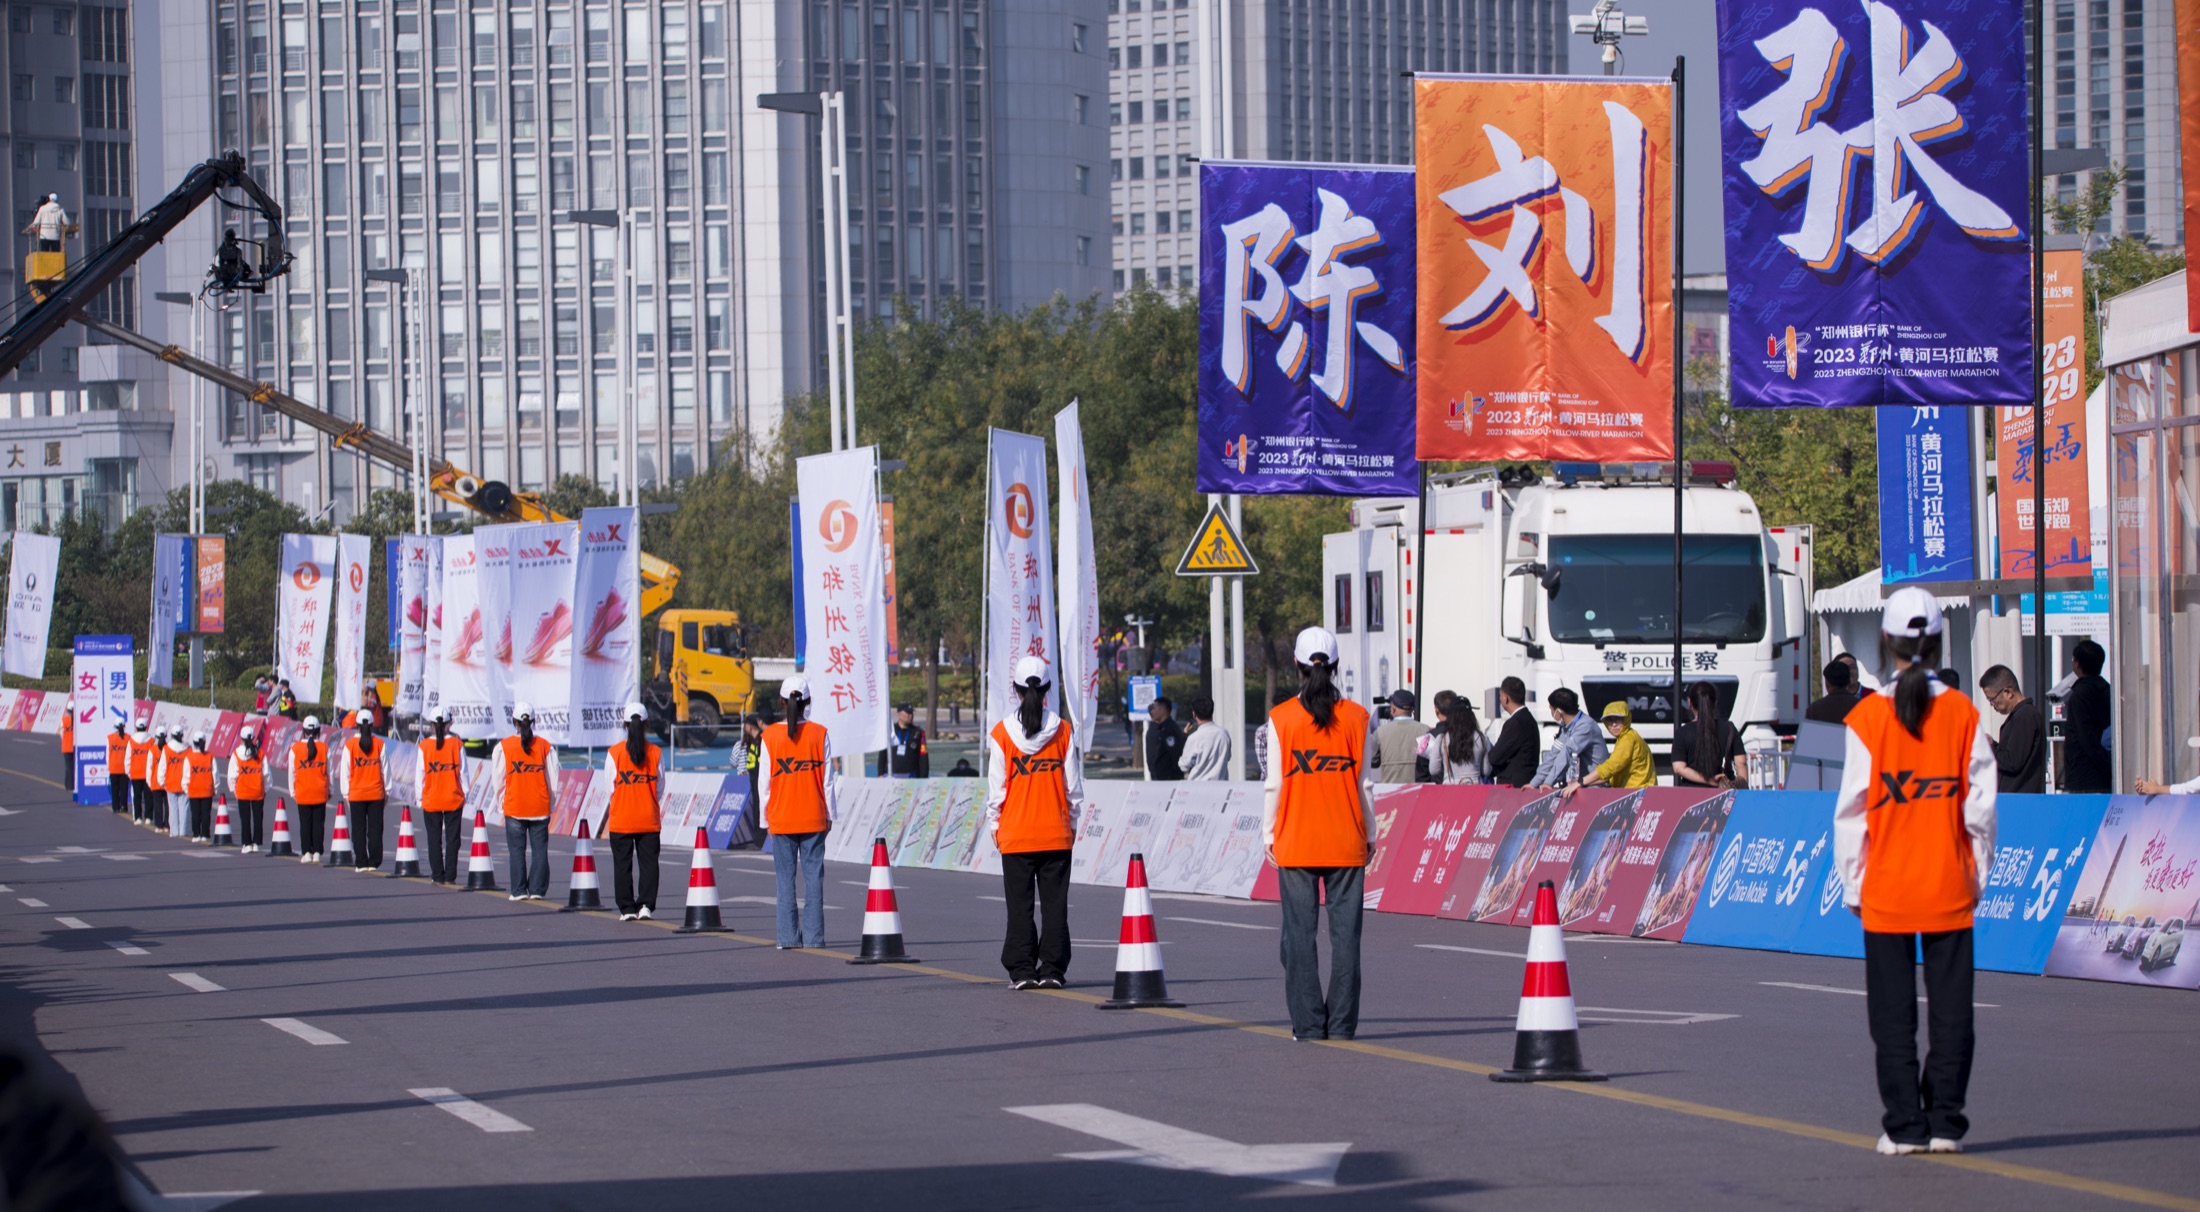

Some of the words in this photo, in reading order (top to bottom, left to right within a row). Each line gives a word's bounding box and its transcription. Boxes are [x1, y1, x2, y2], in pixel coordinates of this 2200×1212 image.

[1737, 0, 2020, 270] 张
[1438, 101, 1652, 372] 刘
[1220, 187, 1407, 415] 陈
[1814, 348, 1856, 364] 2023
[1814, 370, 1835, 379] 2023
[1950, 368, 2000, 378] MARATHON
[1486, 411, 1521, 424] 2023
[1601, 430, 1644, 438] MARATHON
[7, 441, 62, 468] 大厦
[1258, 452, 1289, 464] 2023
[1008, 552, 1020, 589] BANK
[1012, 593, 1021, 614] OF
[1603, 651, 1627, 671] 警
[1632, 656, 1691, 668] POLIE
[1694, 651, 1718, 671] 察
[78, 671, 97, 691] 女
[110, 672, 127, 691] 男
[426, 762, 460, 774] XTEP
[508, 761, 546, 775] XTEP
[772, 757, 824, 779] XTEP
[1008, 753, 1064, 782] XTEP
[1285, 749, 1358, 778] XTEP
[617, 770, 657, 786] XTEP
[1741, 837, 1785, 875] 中国移动
[1728, 879, 1748, 903] China
[1744, 880, 1769, 904] Mobile
[1987, 893, 2015, 919] Mobile
